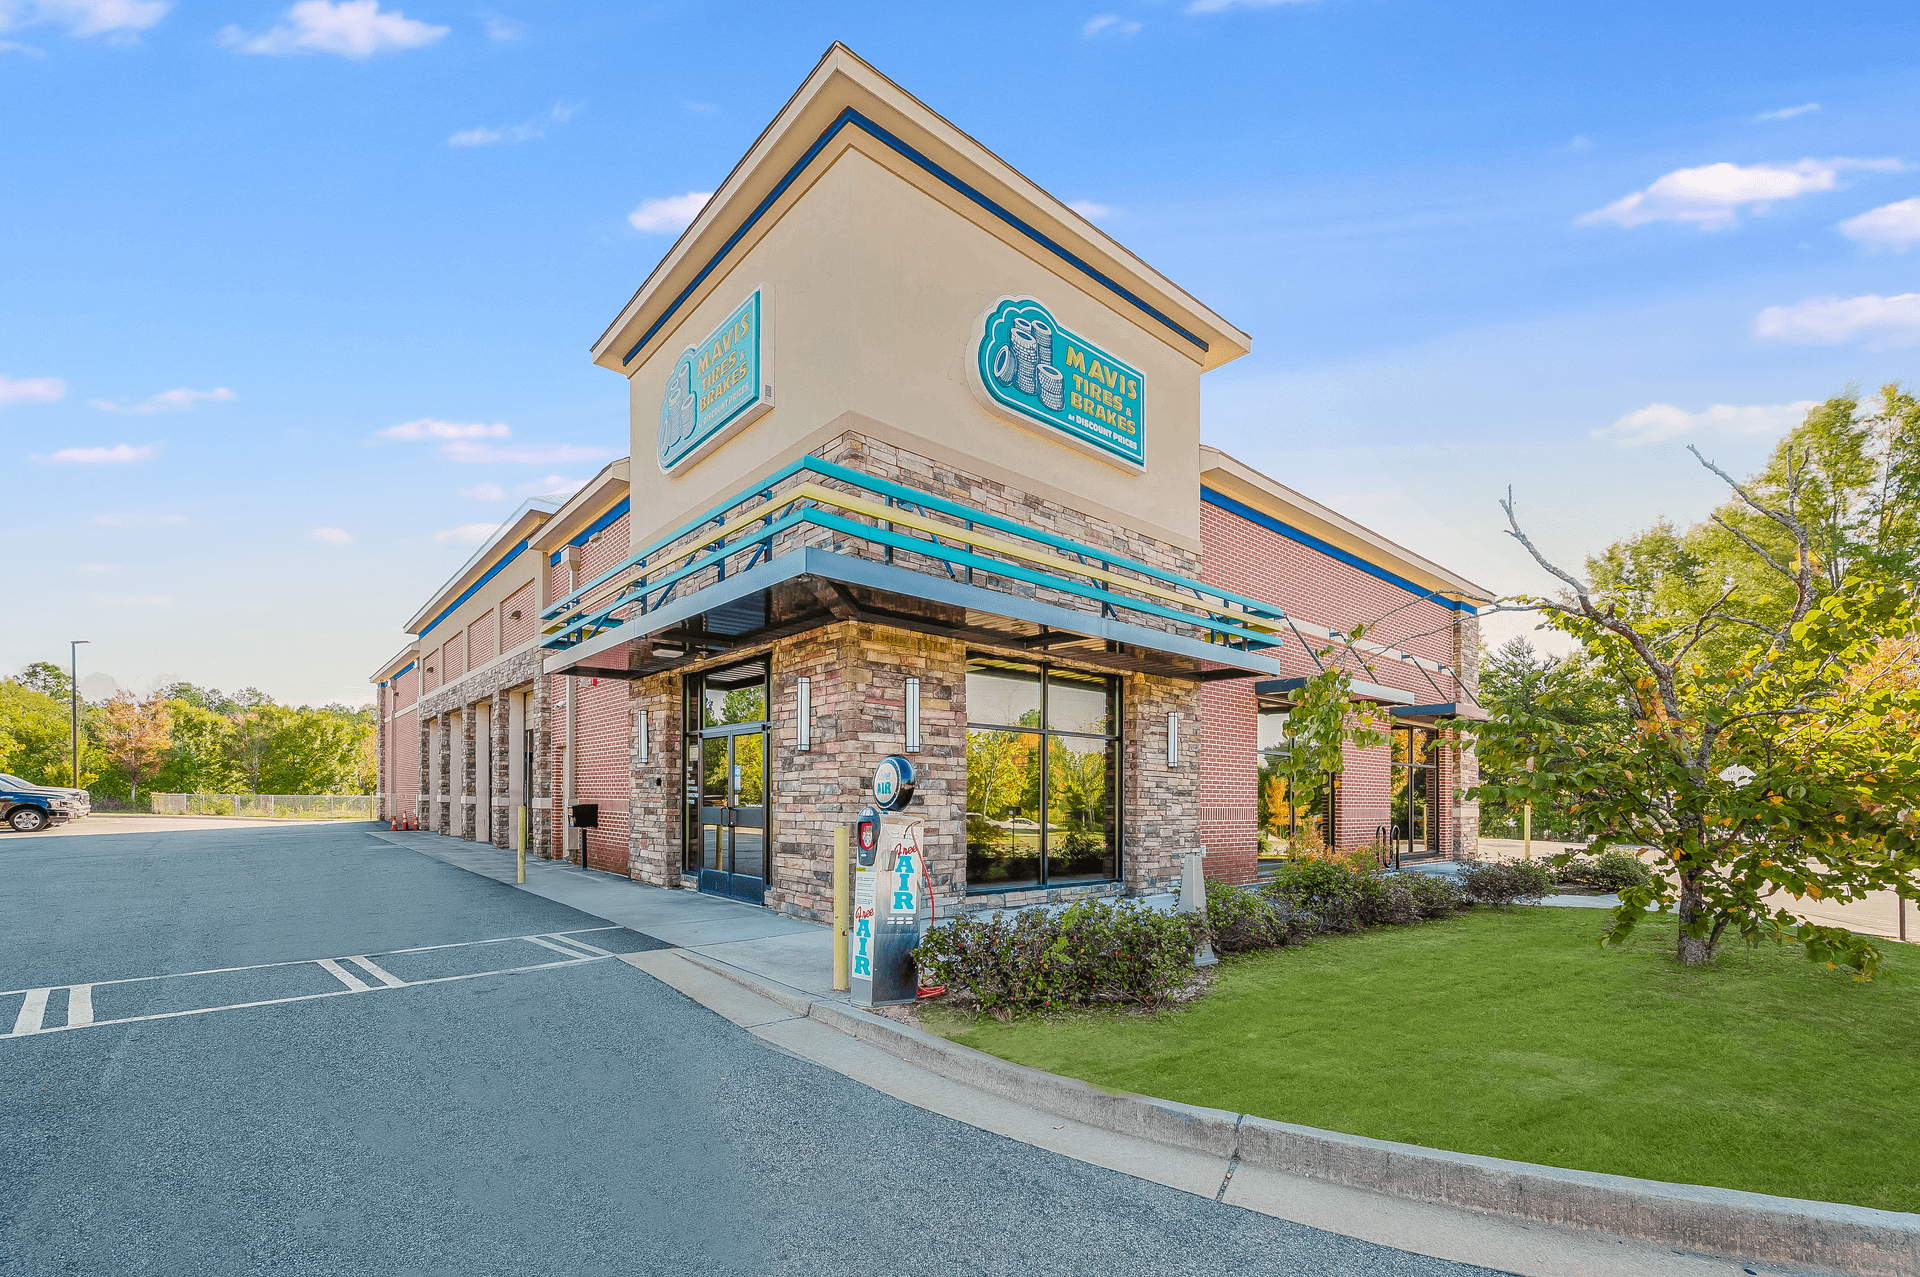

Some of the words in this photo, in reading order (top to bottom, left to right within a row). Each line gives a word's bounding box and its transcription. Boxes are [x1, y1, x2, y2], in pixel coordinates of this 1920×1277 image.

[697, 311, 749, 378] MAVIS
[700, 361, 748, 413] BRAKES
[701, 350, 737, 391] TIRES
[739, 350, 745, 362] &
[1066, 345, 1137, 399] MAVIS
[1070, 391, 1136, 435] BRAKES
[1073, 373, 1122, 411] TIRES
[1125, 407, 1133, 417] &
[1076, 415, 1112, 438] DISCOUNT
[1113, 432, 1138, 450] PRICES
[877, 781, 892, 795] AIR
[893, 842, 918, 859] Free
[893, 855, 915, 910] AIR
[855, 906, 875, 922] Free
[854, 919, 871, 976] AIR
